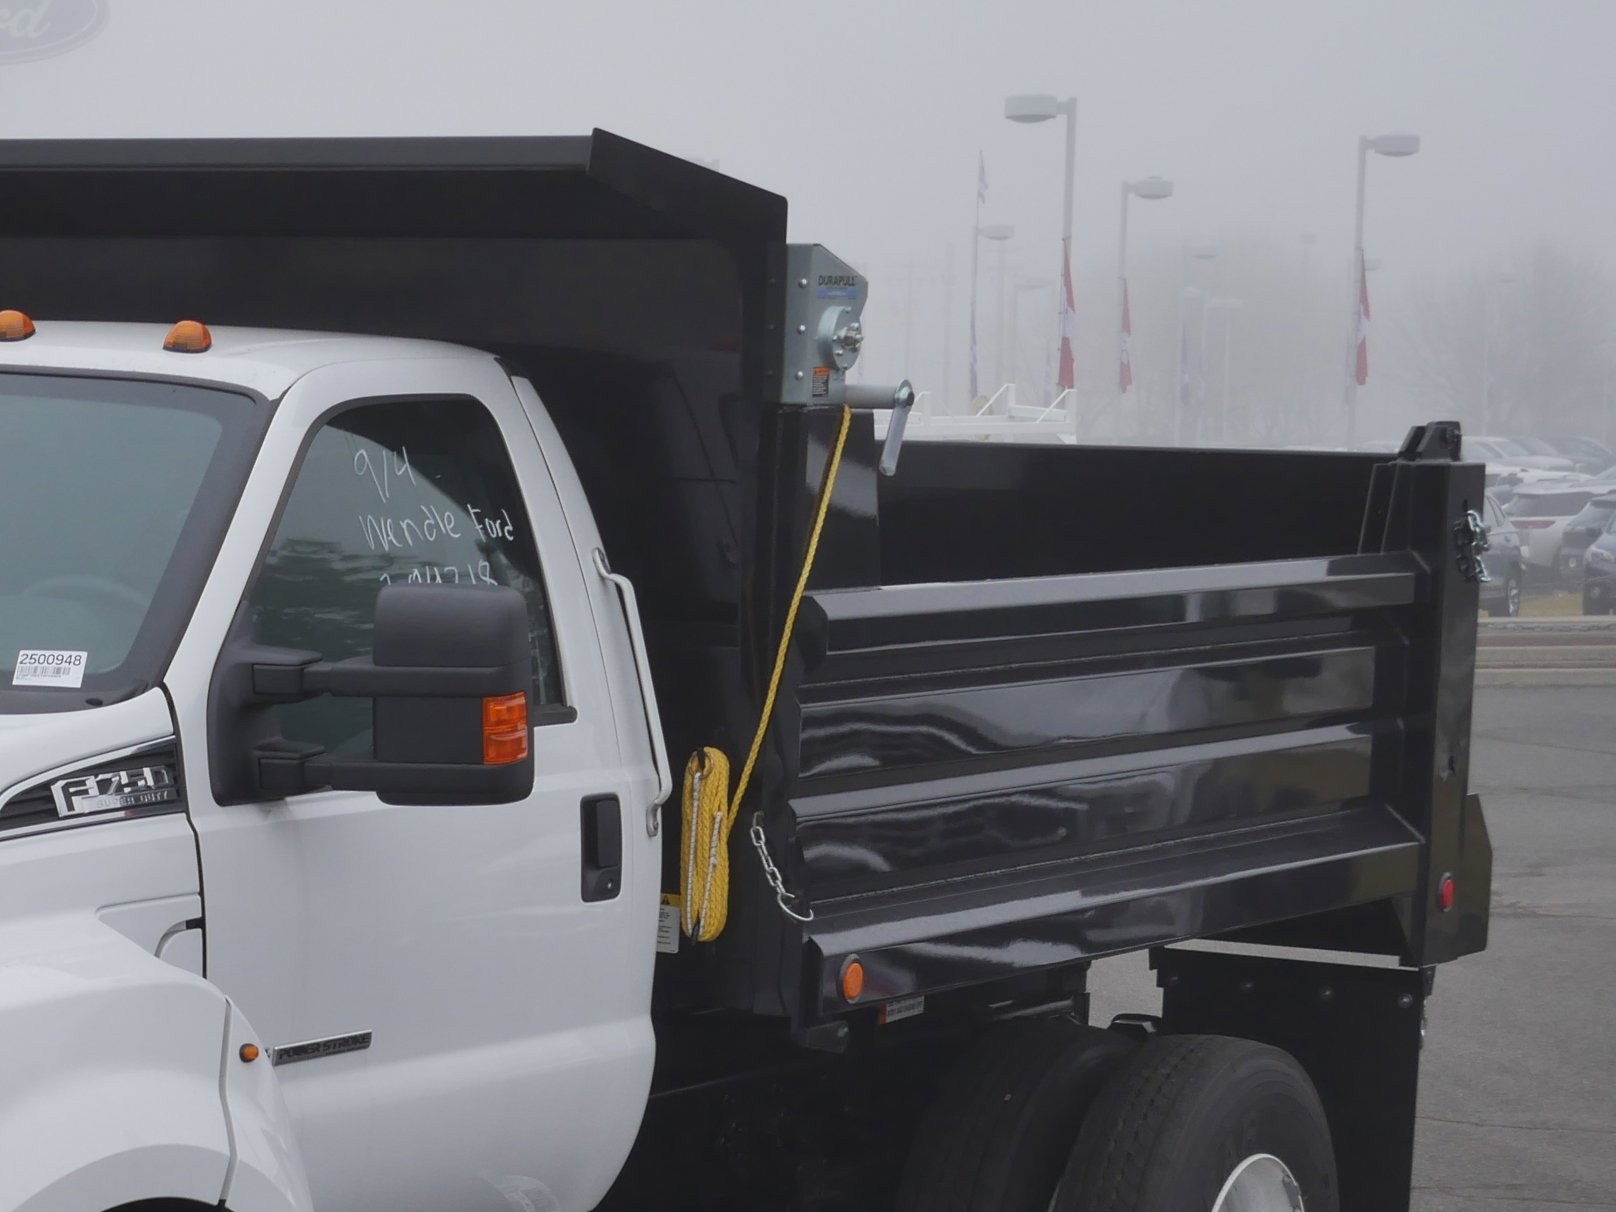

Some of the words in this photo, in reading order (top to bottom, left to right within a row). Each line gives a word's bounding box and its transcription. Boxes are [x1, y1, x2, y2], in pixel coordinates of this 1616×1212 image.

[818, 275, 856, 287] DURAPULL
[358, 504, 462, 551] Wendle
[467, 503, 514, 543] Ford
[19, 653, 82, 667] 2500948
